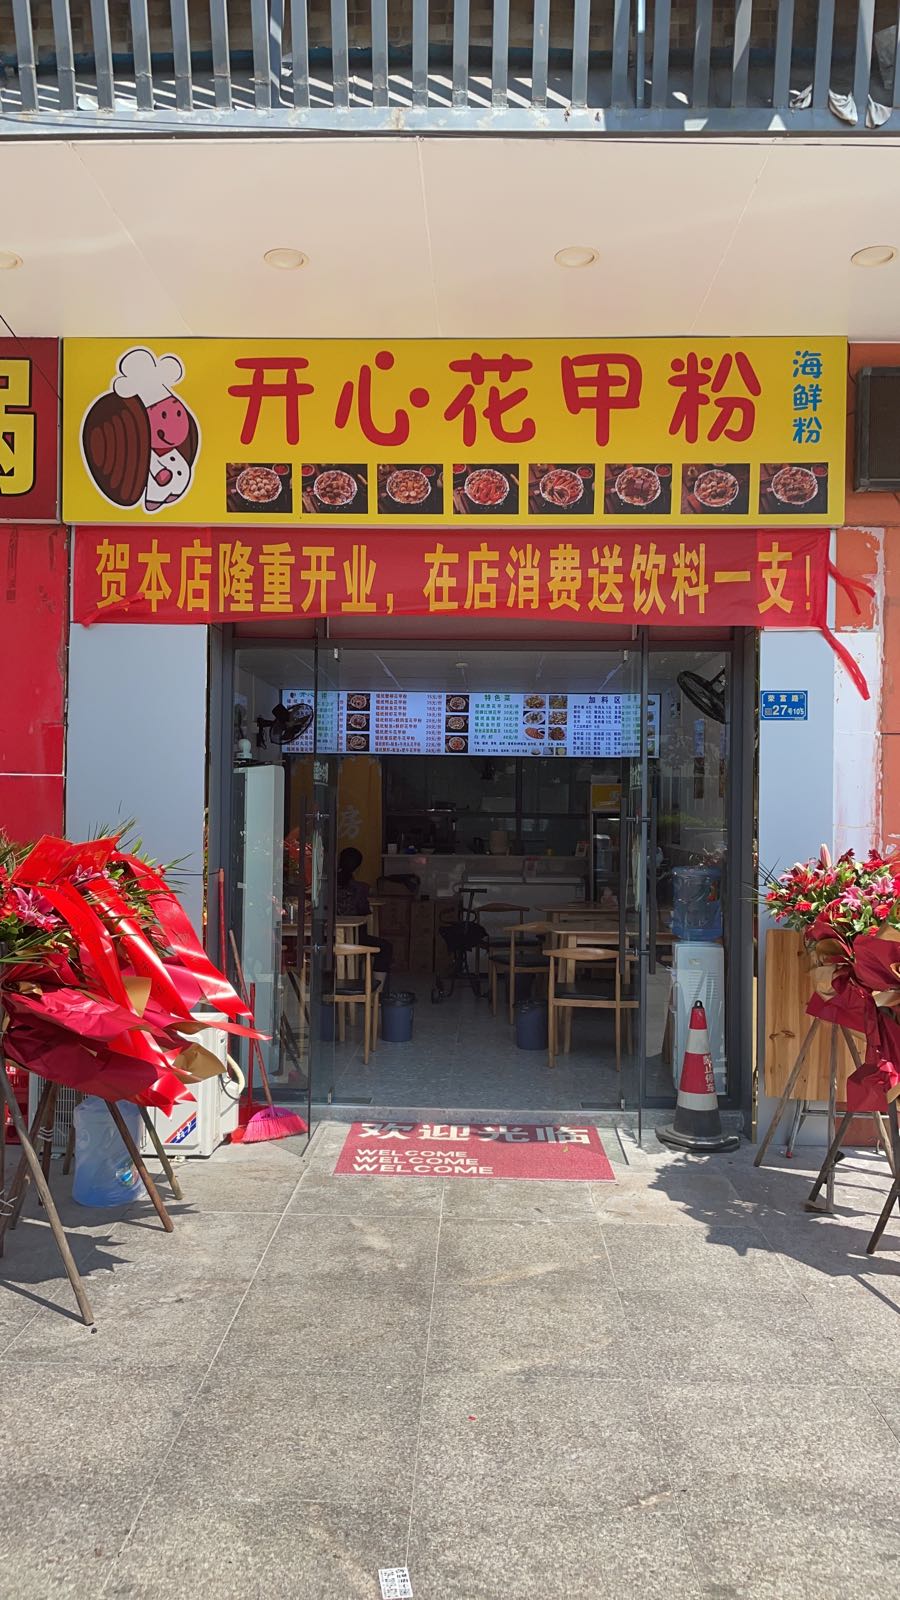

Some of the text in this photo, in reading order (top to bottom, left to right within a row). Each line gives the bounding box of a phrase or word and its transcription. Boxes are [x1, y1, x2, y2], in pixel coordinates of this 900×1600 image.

[228, 351, 762, 446] 开心花甲粉
[792, 350, 824, 444] 海鲜粉
[358, 1123, 591, 1144] 欢迎光临
[354, 1156, 479, 1165] WELCOME
[356, 1149, 468, 1158] WELCOME
[352, 1163, 494, 1175] WELCOME
